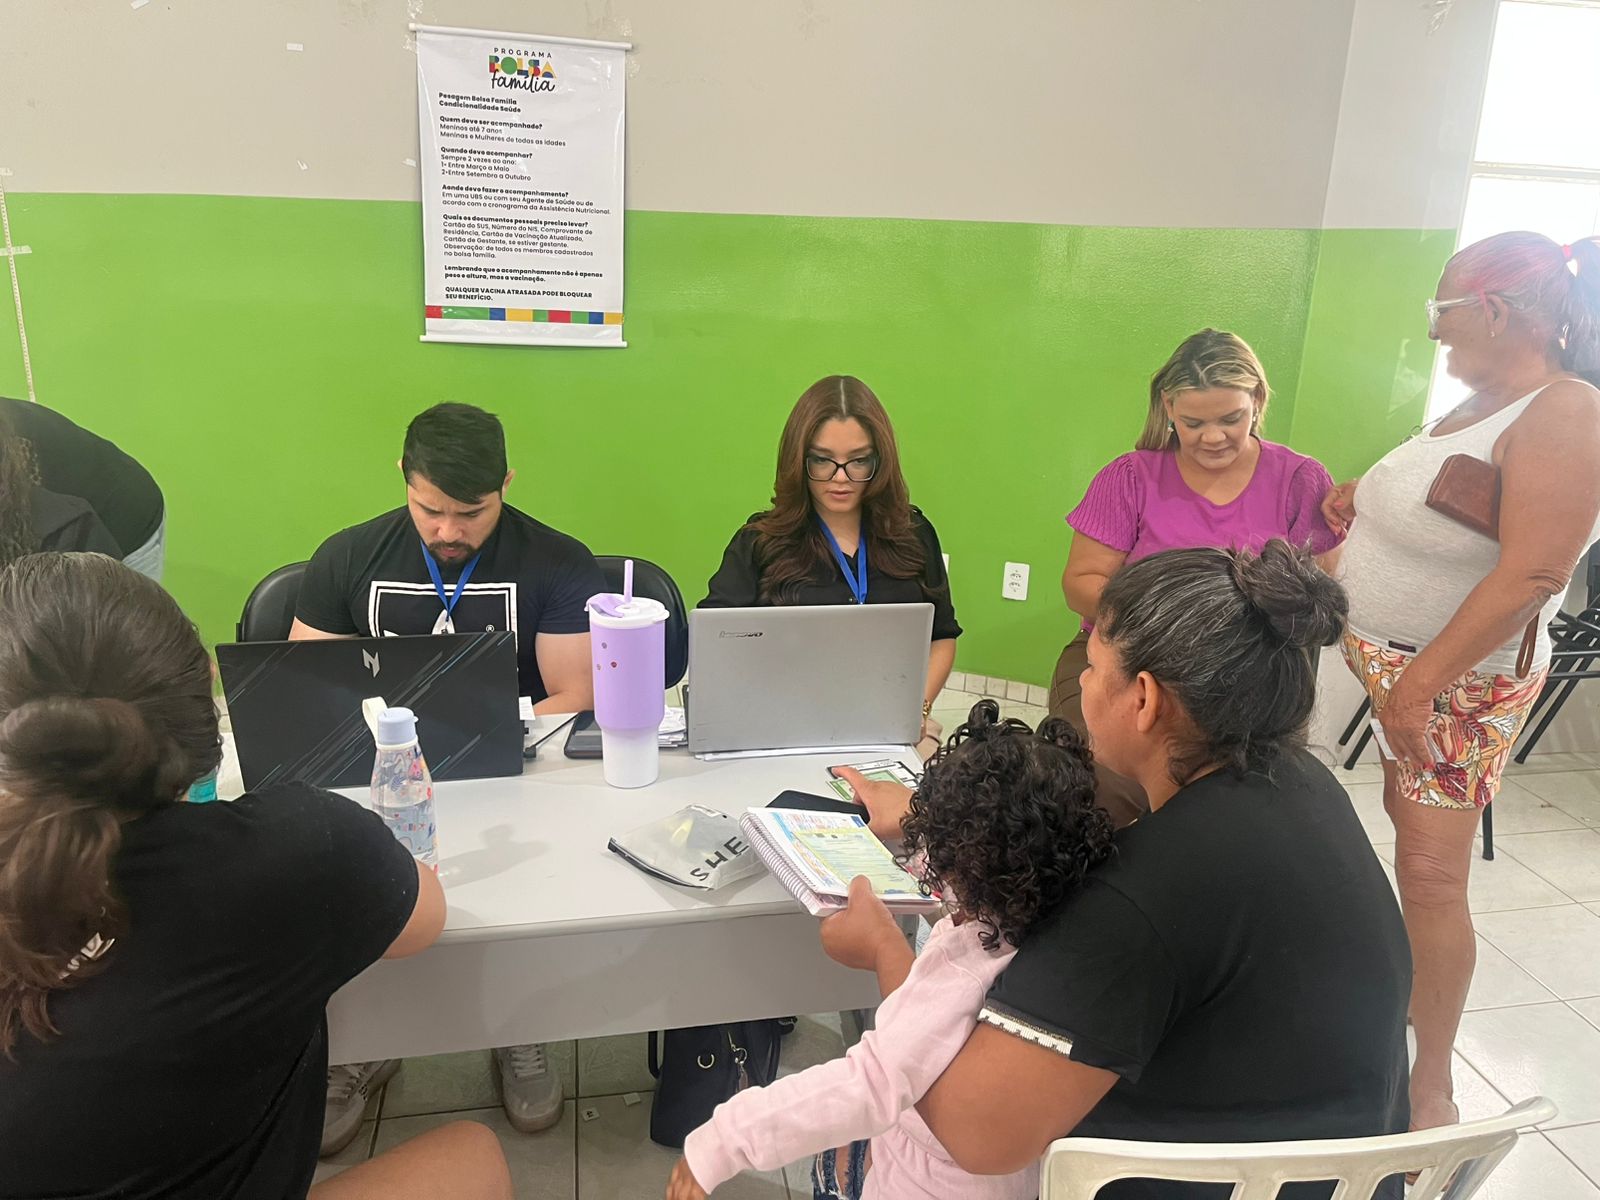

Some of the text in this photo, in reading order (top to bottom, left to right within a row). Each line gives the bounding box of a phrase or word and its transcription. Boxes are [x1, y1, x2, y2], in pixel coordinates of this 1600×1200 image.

[494, 48, 552, 58] PROGRAMA
[489, 55, 557, 78] BOLSA
[491, 68, 555, 93] família
[439, 92, 470, 101] Pesagem
[439, 100, 499, 110] Condicionalidade
[491, 121, 542, 129] acompanhado?
[441, 154, 466, 162] Sempre
[466, 163, 487, 171] Março
[514, 232, 548, 240] Vacinação
[444, 243, 484, 251] Observação:
